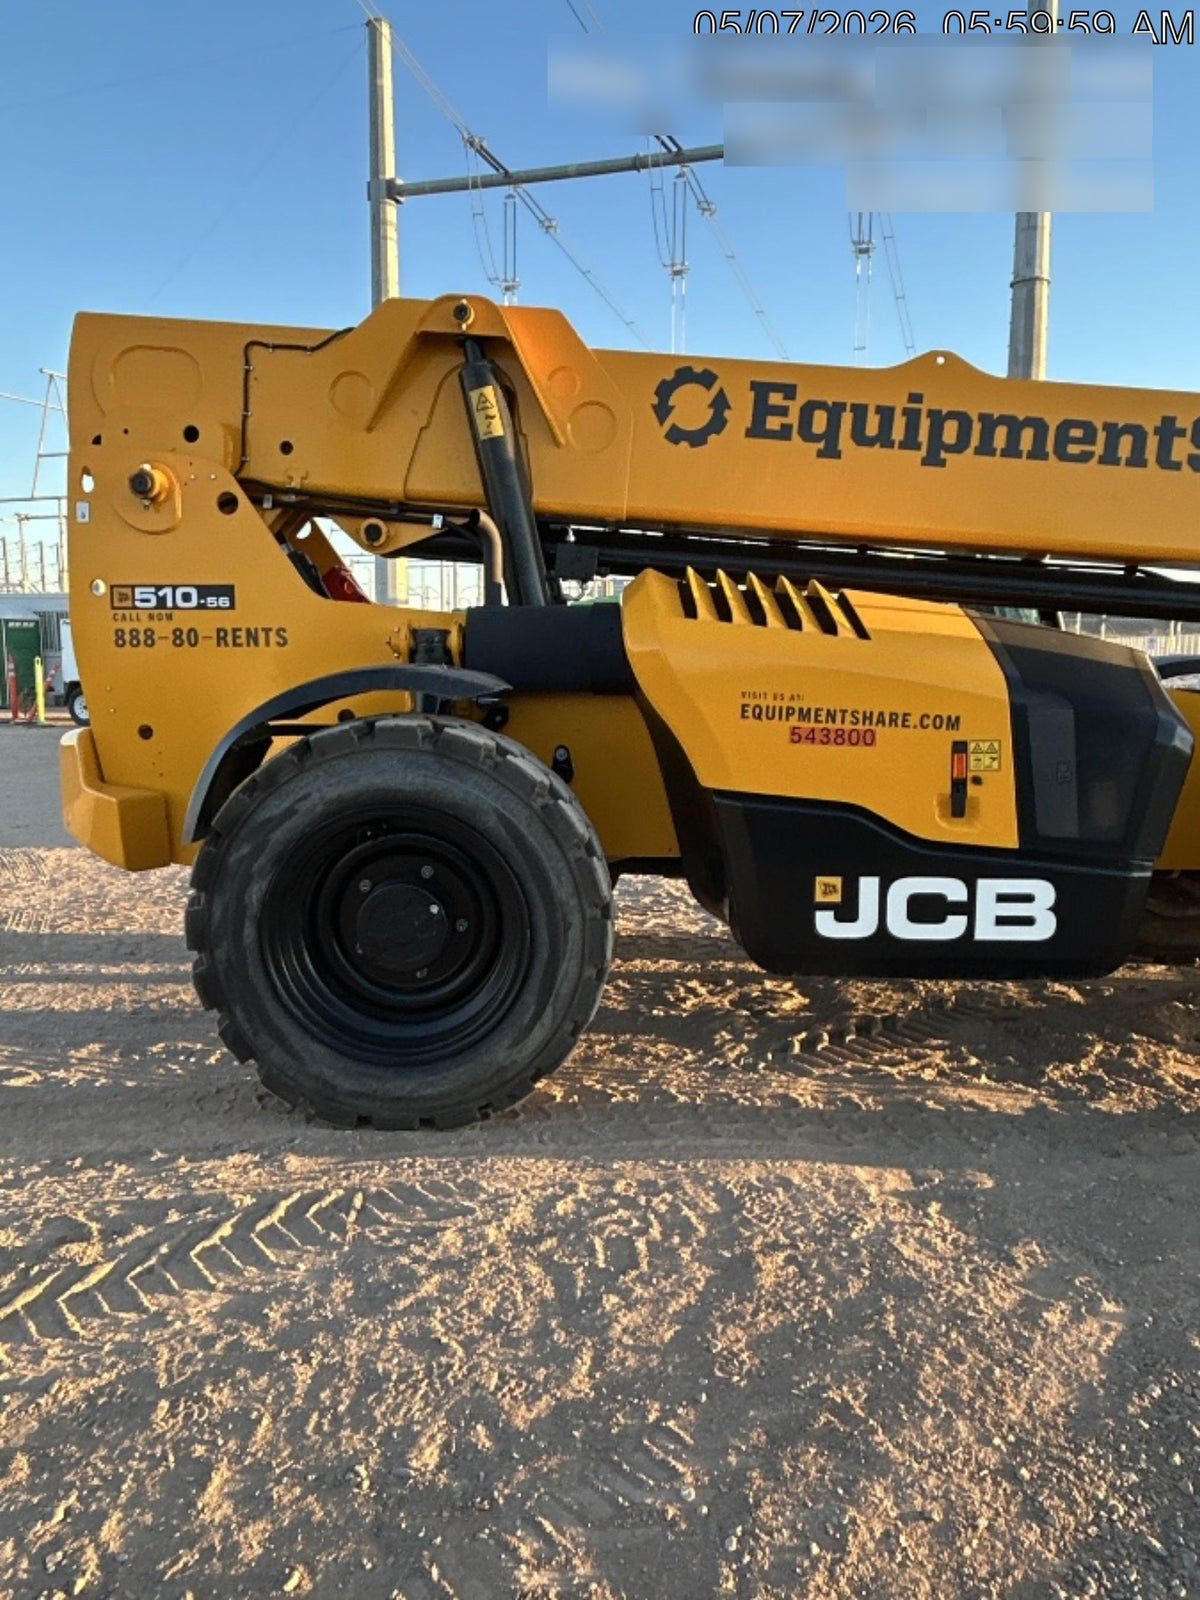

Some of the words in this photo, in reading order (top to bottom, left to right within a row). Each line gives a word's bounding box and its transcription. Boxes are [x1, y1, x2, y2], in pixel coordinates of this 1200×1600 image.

[112, 613, 142, 622] CALL
[147, 613, 174, 621] NOW
[114, 627, 288, 648] 888-80-RENTS
[741, 691, 768, 700] VISIT
[773, 692, 785, 701] US
[740, 703, 961, 731] EQUIPMENTSHARE.COM
[790, 727, 876, 746] 543800
[815, 876, 1057, 941] JCB
